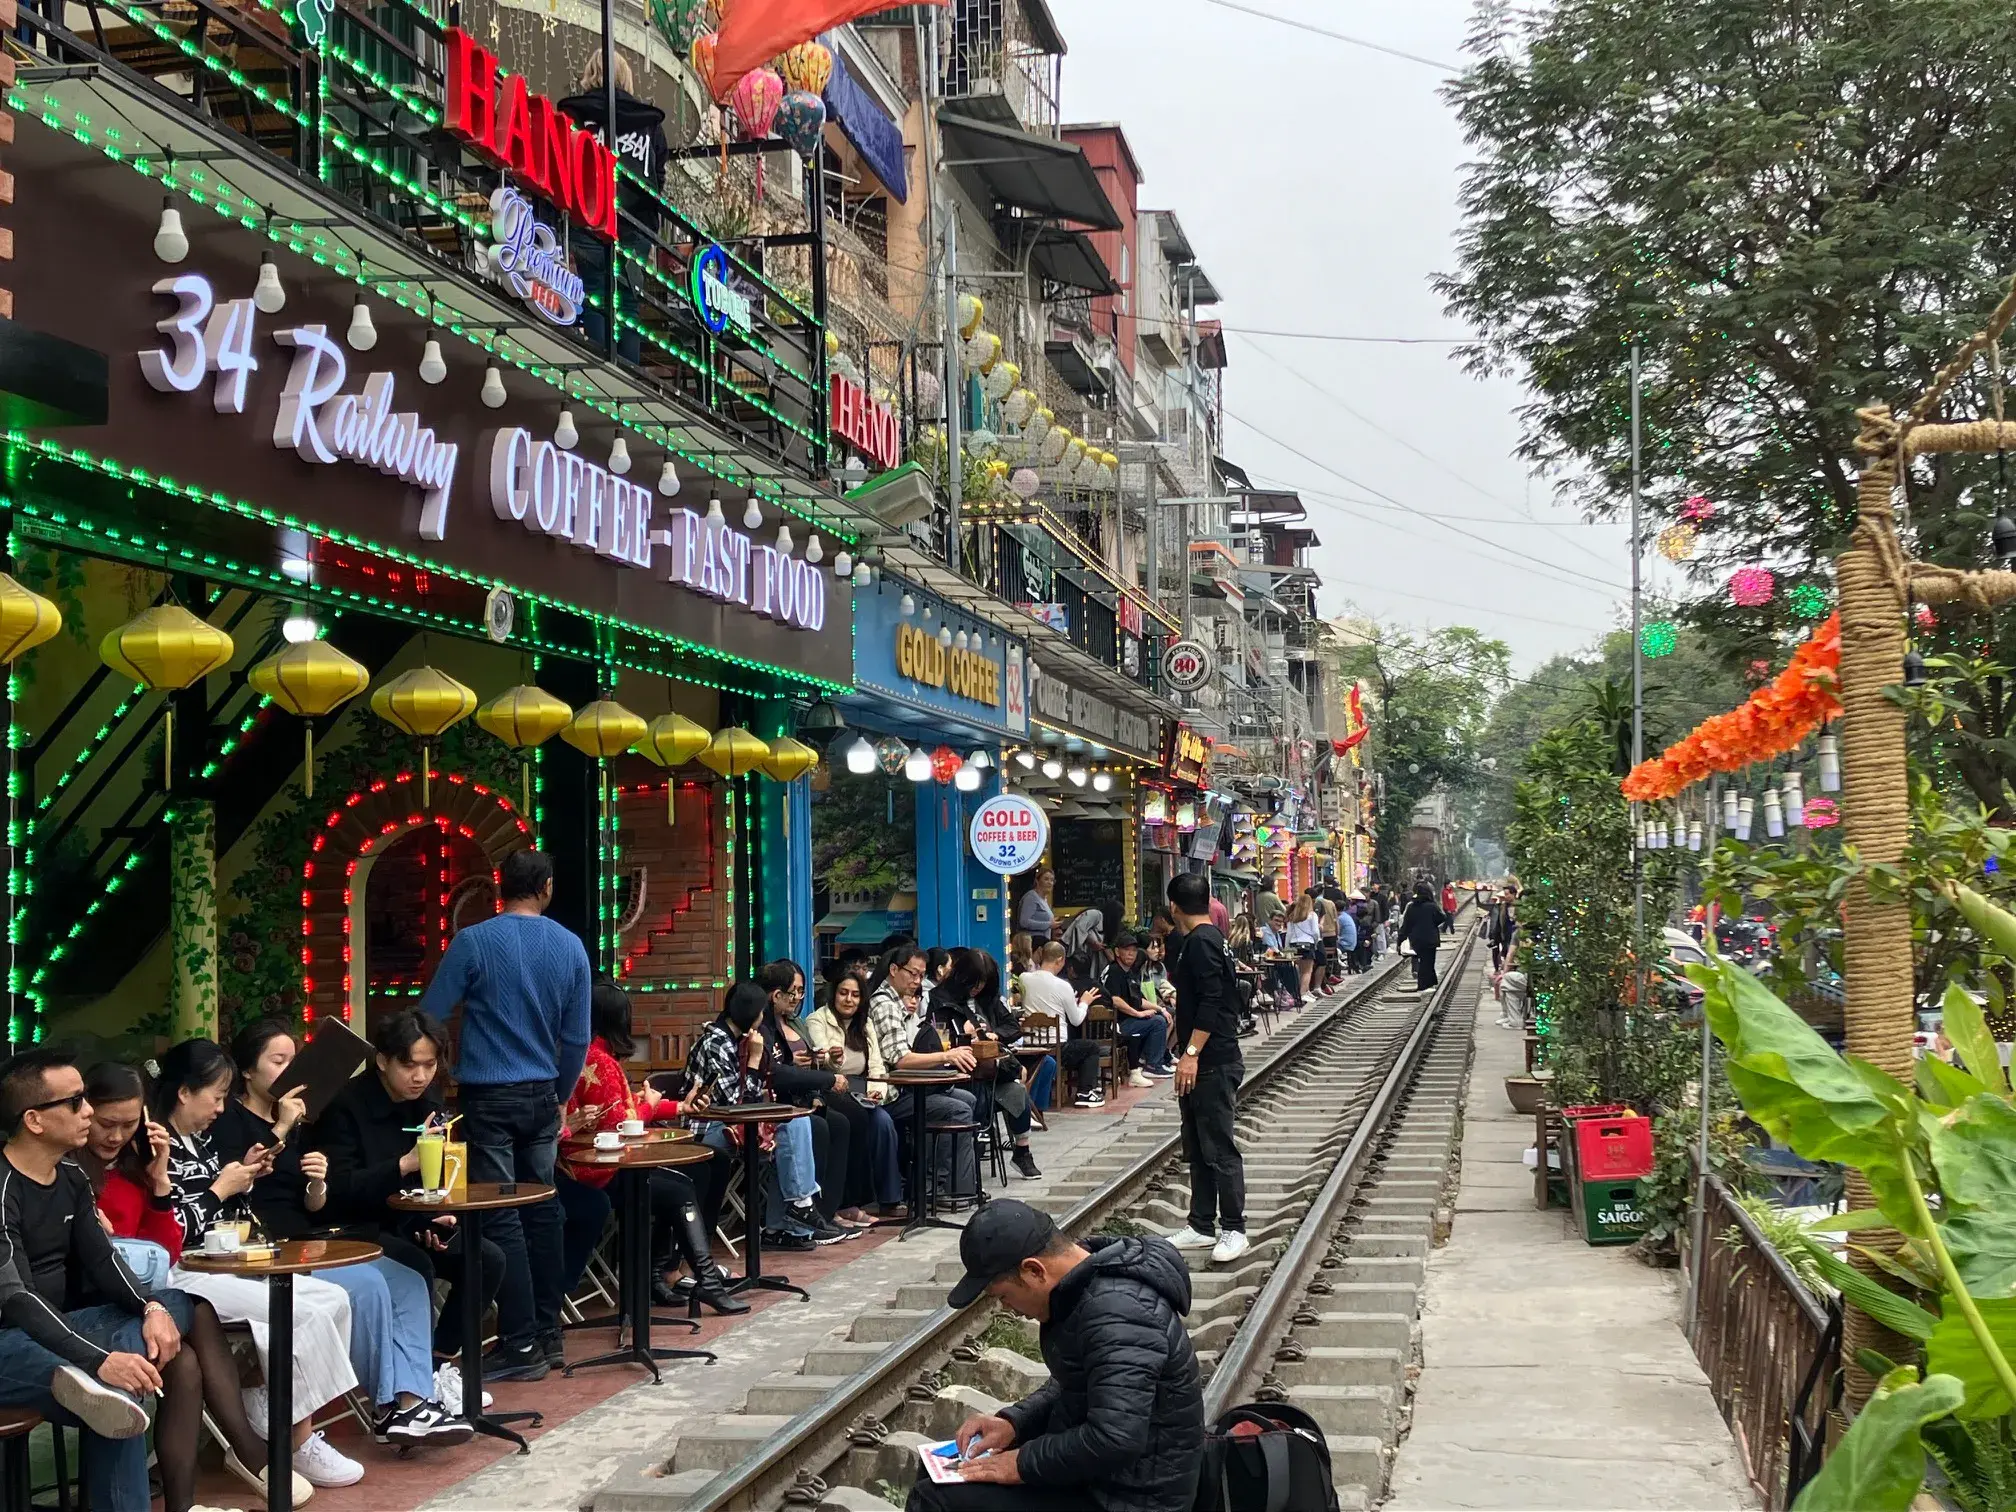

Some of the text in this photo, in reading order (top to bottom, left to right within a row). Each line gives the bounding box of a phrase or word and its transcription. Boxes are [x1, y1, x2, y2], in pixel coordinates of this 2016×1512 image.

[443, 27, 618, 239] HANOI
[498, 187, 585, 305] Premium
[702, 269, 751, 333] TUBORG
[138, 275, 458, 541] 34 Railway
[831, 374, 901, 469] HANOI
[490, 427, 652, 568] COFFEE
[669, 507, 751, 606] FAST
[750, 544, 825, 632] FOOD
[896, 622, 1000, 708] GOLD COFFEE
[977, 830, 1038, 842] COFFEE & BEER
[983, 810, 1031, 827] GOLD
[998, 845, 1016, 857] 32
[1614, 1203, 1632, 1211] BIA
